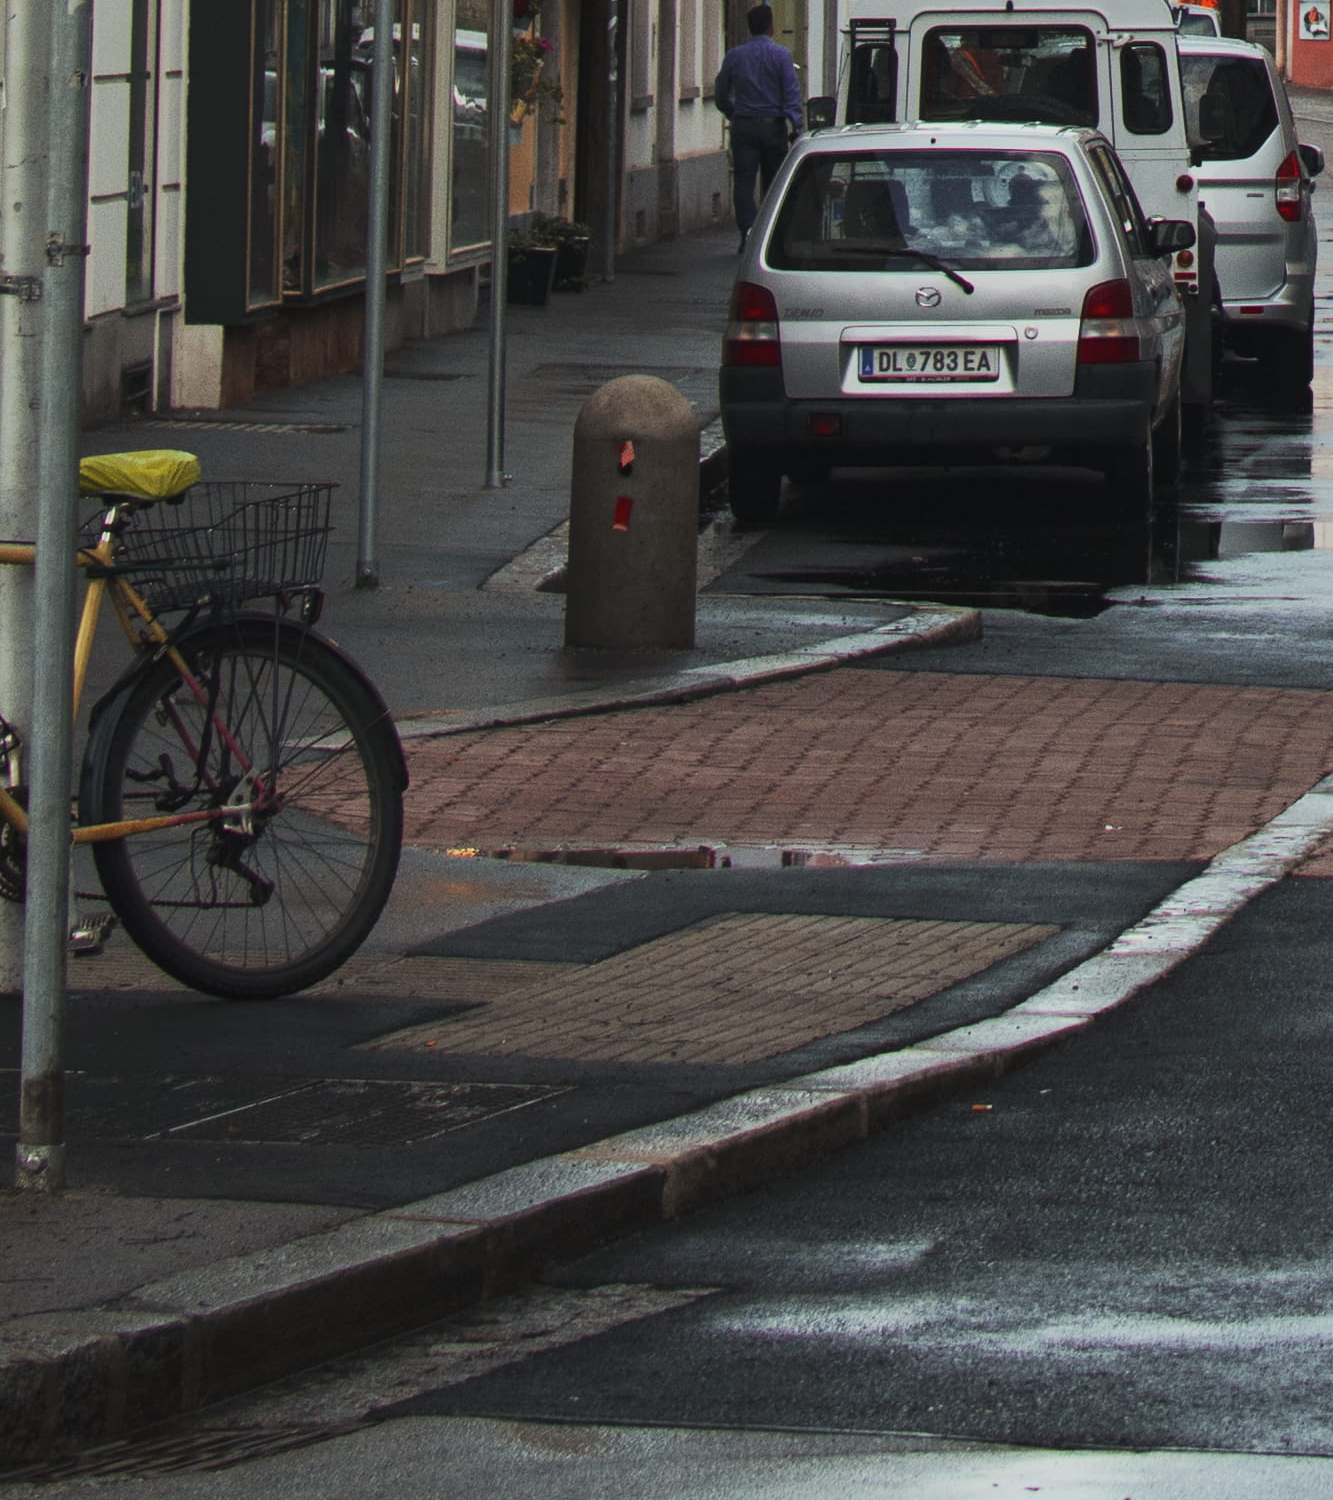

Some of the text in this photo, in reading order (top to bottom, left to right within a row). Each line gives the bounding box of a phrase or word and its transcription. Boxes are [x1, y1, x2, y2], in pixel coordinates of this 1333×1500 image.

[878, 351, 902, 372] DL
[920, 351, 958, 372] 783
[964, 351, 991, 372] EA
